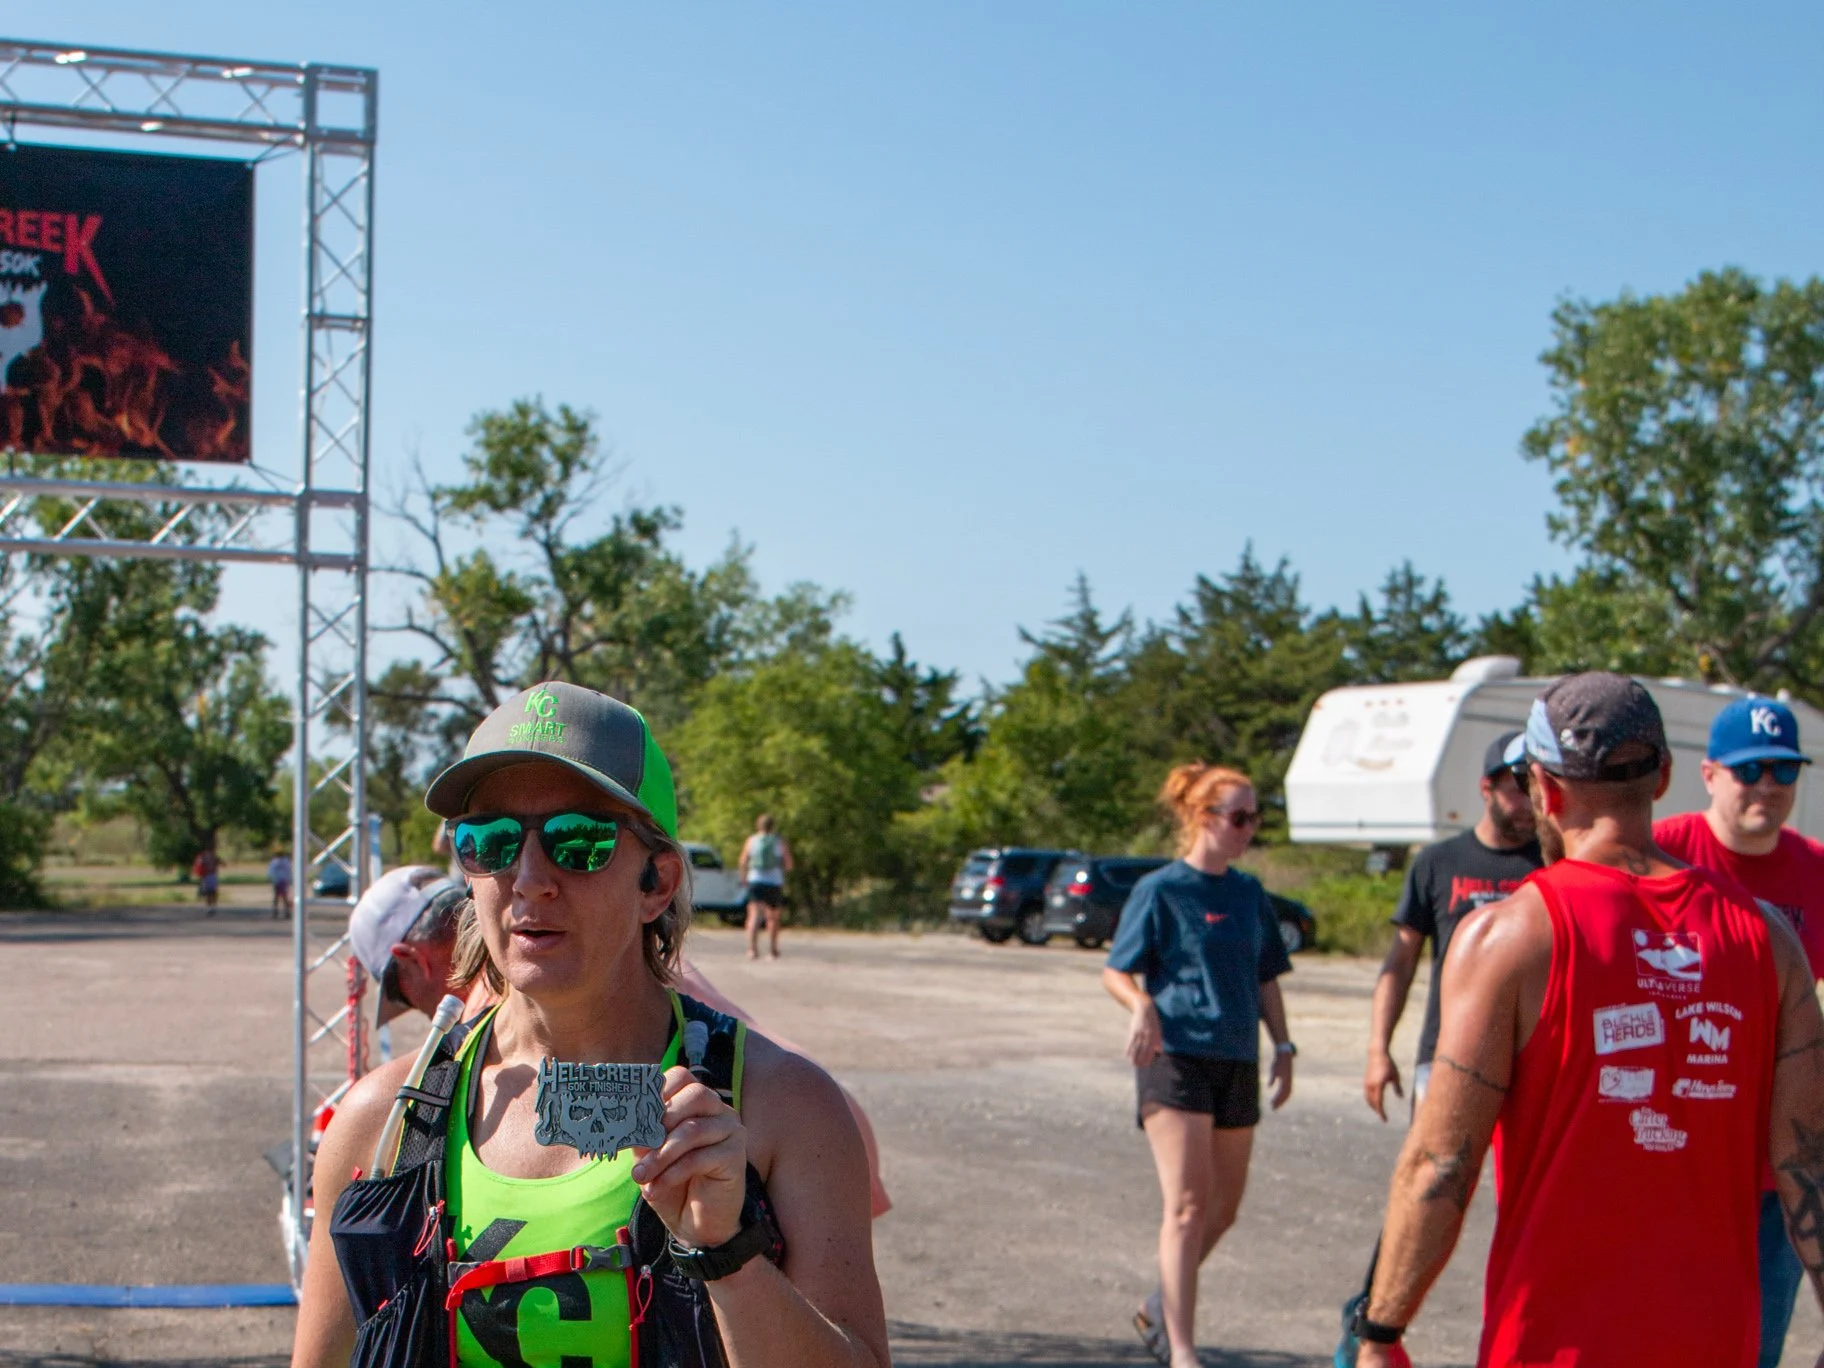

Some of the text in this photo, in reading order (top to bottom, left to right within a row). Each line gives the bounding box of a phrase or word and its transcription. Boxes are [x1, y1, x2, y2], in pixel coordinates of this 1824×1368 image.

[525, 689, 559, 718] KC
[509, 721, 567, 738] SMART
[1750, 706, 1782, 737] KC
[1637, 978, 1701, 994] ULTAVERSE
[1675, 1001, 1704, 1019] LAKE
[1686, 1053, 1729, 1065] MARINA
[535, 1055, 663, 1113] HELL CREEK
[589, 1081, 631, 1093] FINISHER
